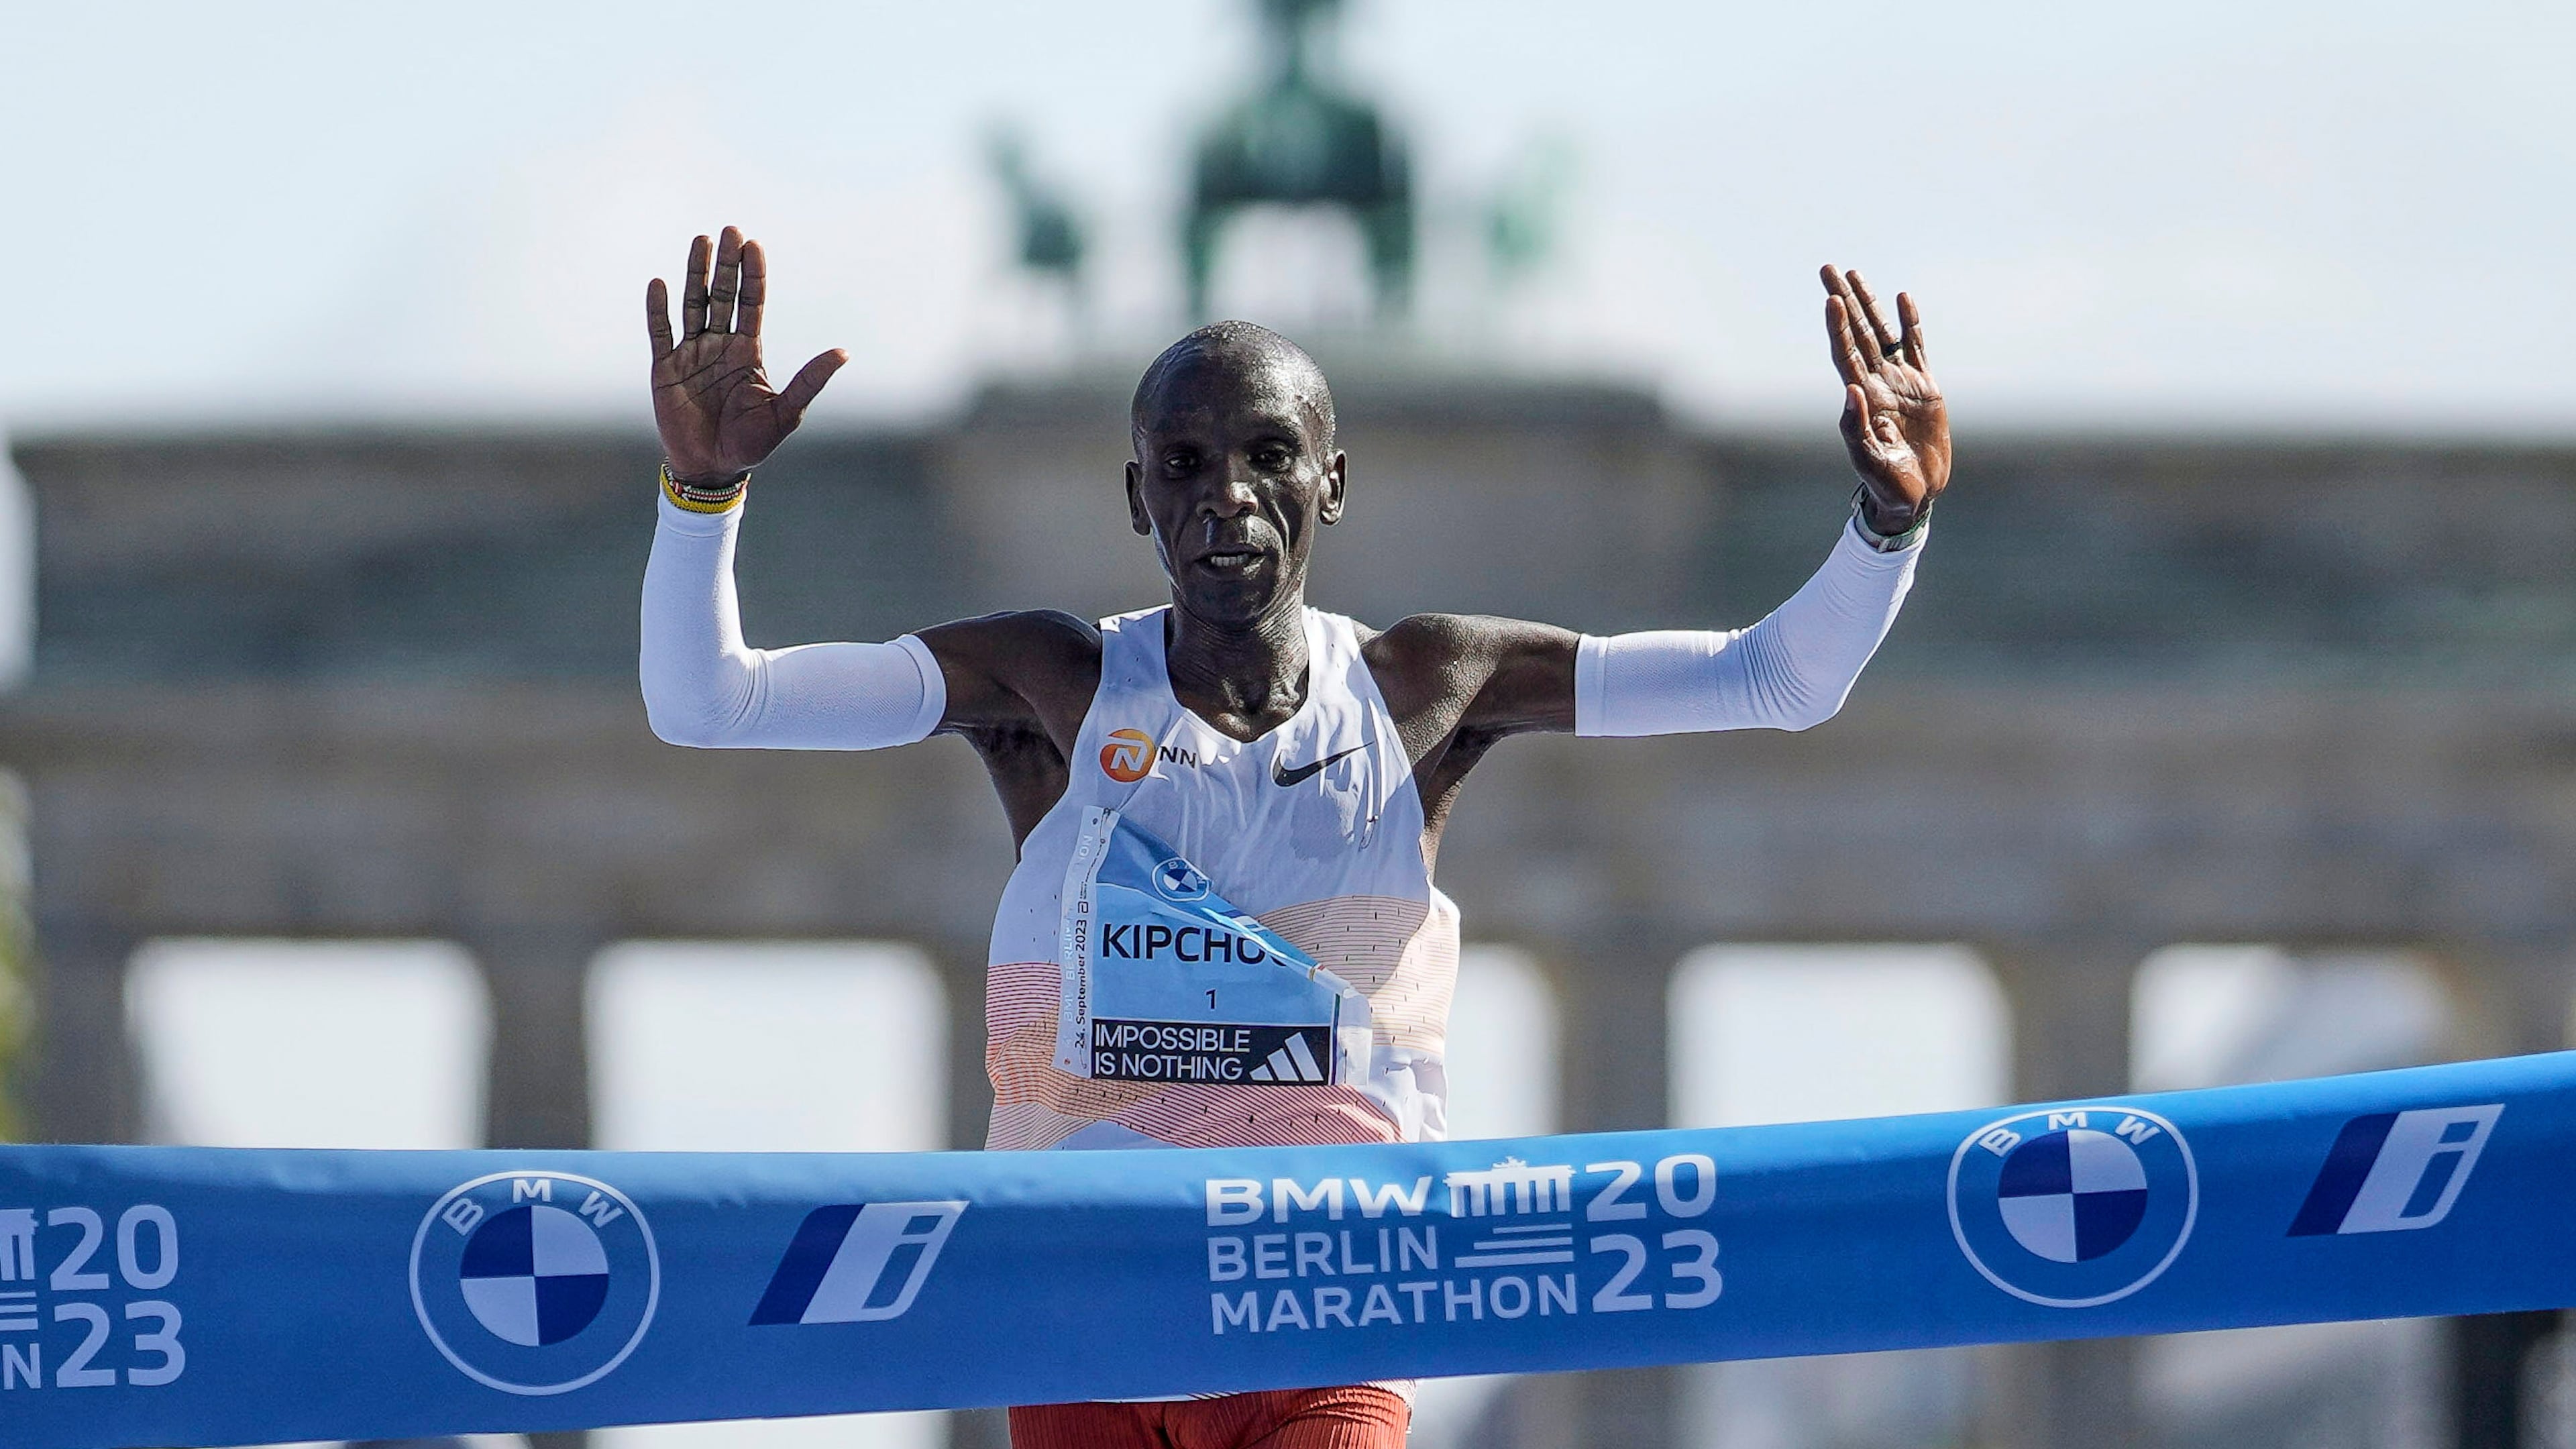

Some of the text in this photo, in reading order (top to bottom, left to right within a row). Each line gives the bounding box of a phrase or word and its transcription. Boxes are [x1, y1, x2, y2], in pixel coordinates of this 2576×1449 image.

[1159, 746, 1197, 769] NN
[1075, 920, 1087, 952] 2023
[1102, 923, 1286, 966] KIPCHO
[1076, 954, 1087, 1026] September
[1205, 989, 1216, 1010] 1
[1095, 1024, 1251, 1053] IMPOSSIBLE
[1095, 1051, 1243, 1081] IS NOTHING
[1978, 1111, 2160, 1158] BMW
[441, 1179, 623, 1236] BMW
[1205, 1175, 1433, 1226] BMW
[1585, 1154, 1717, 1222] 20
[48, 1205, 179, 1291] 20
[1208, 1225, 1438, 1282] BERLIN
[1590, 1230, 1724, 1313] 23
[1210, 1273, 1578, 1335] MARATHON
[54, 1300, 186, 1389] 23
